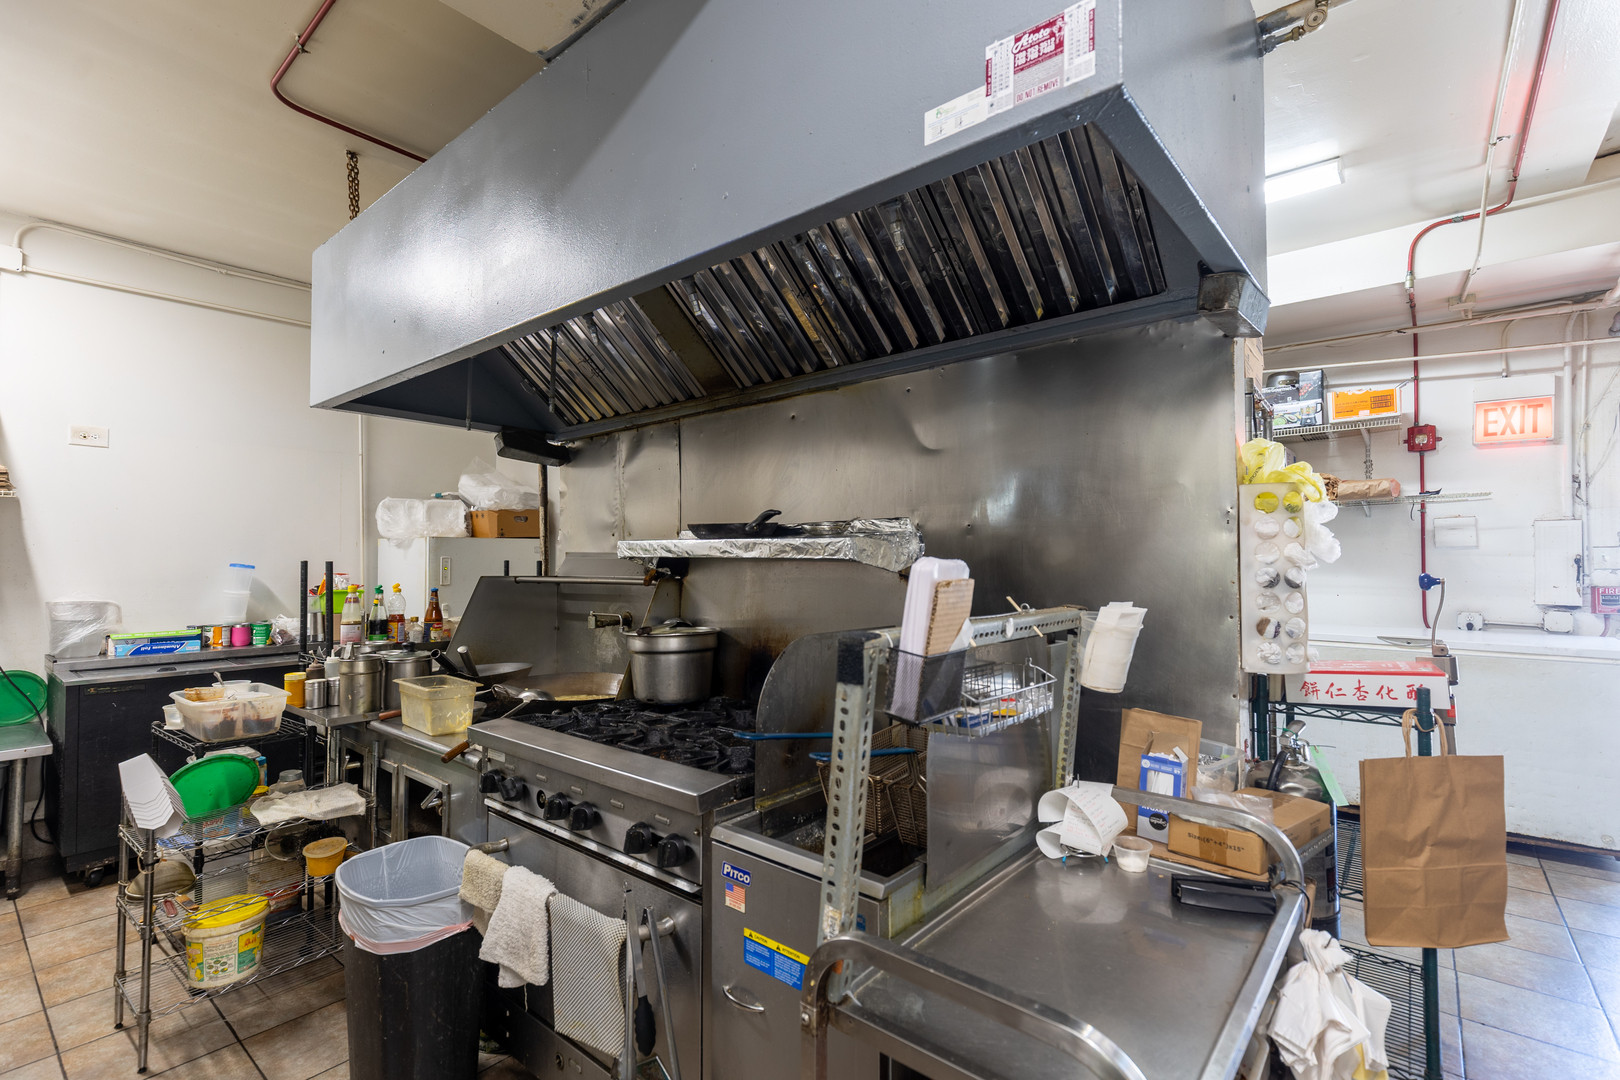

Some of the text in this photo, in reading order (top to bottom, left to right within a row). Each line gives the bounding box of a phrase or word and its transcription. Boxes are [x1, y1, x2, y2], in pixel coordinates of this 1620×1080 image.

[1016, 78, 1059, 103] DO NOT REMOVE
[1483, 403, 1544, 437] EXIT
[723, 864, 750, 884] PITCO
[753, 934, 768, 944] CAUTION
[782, 947, 801, 959] ATTENTION
